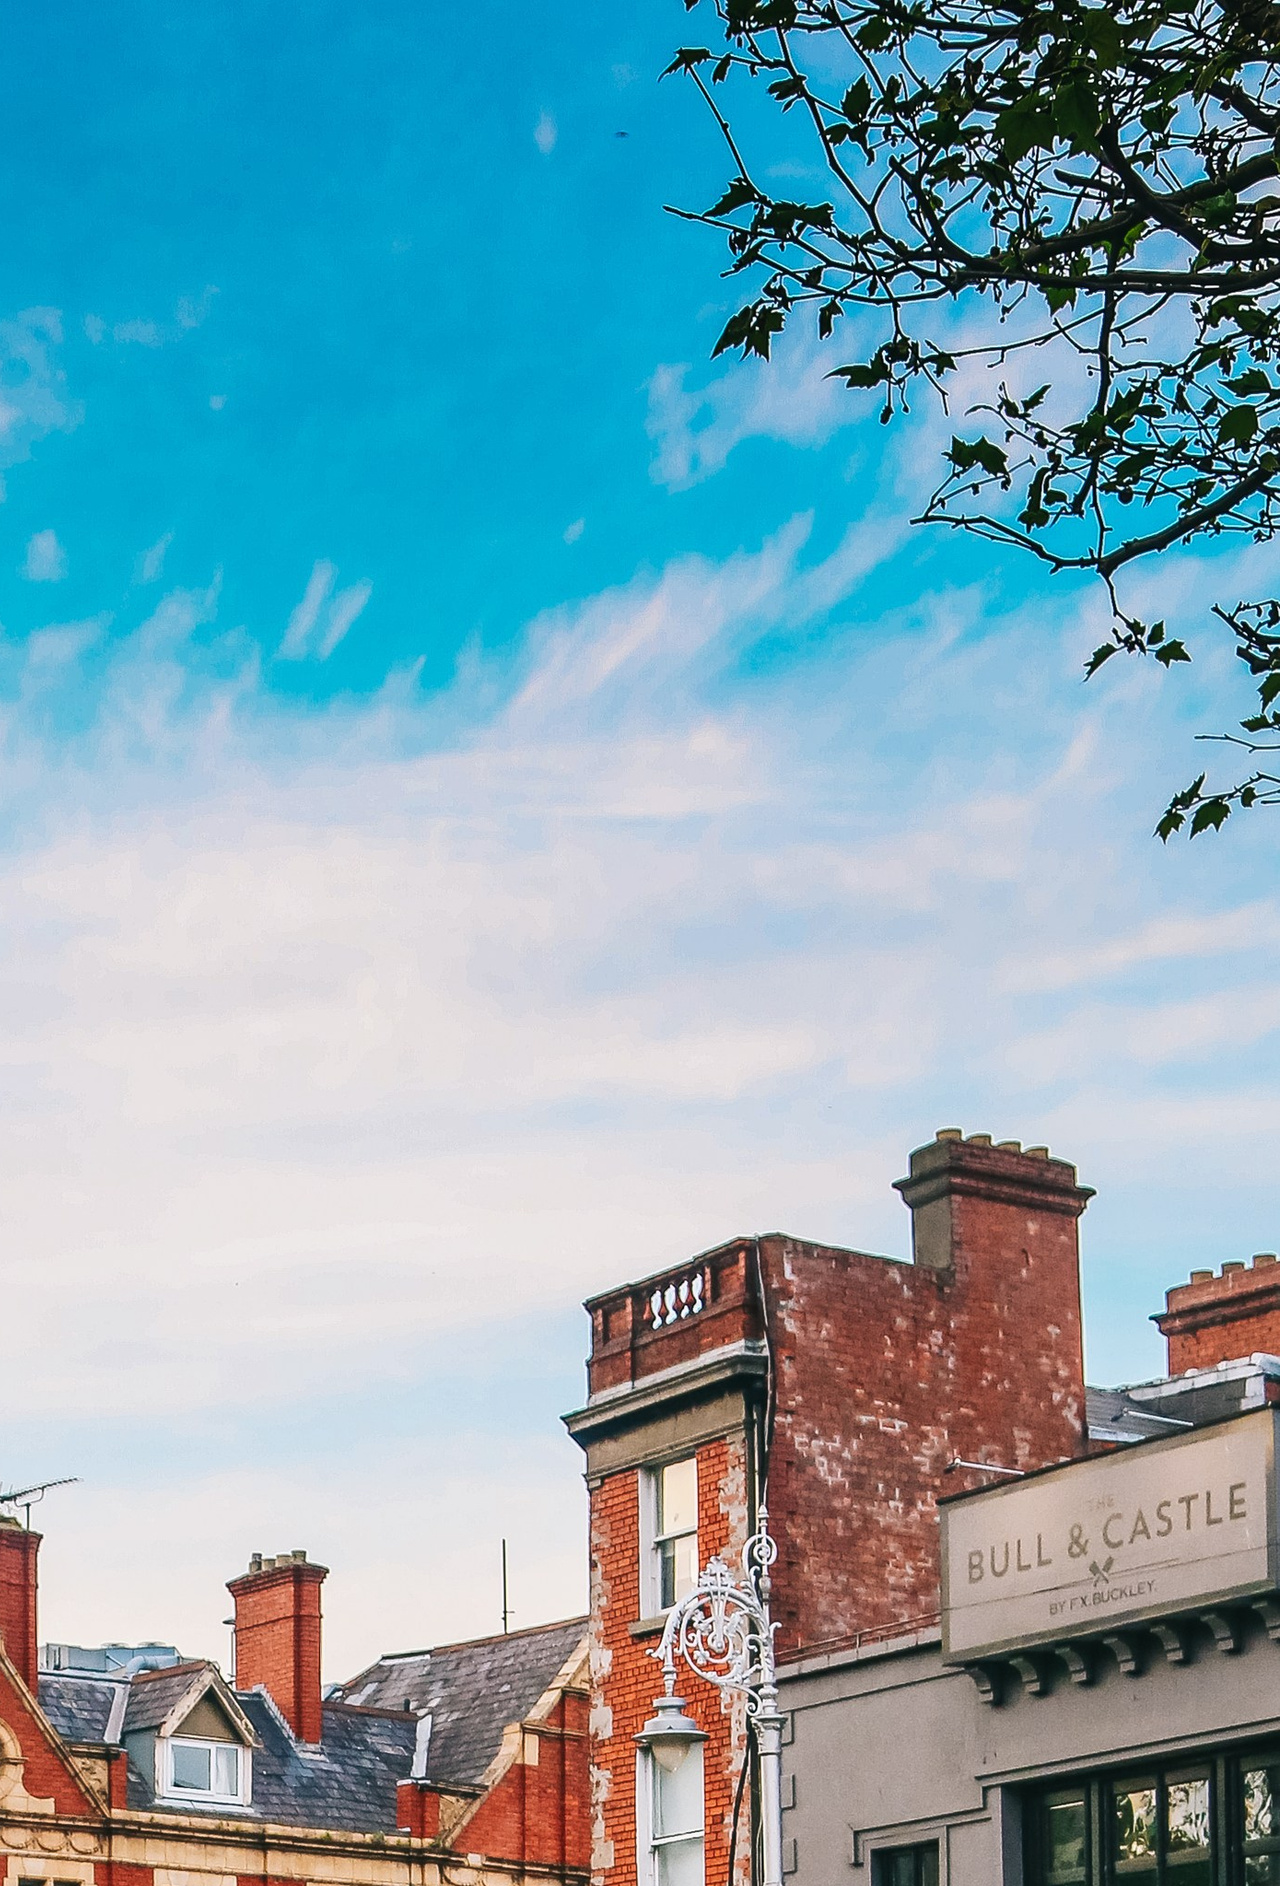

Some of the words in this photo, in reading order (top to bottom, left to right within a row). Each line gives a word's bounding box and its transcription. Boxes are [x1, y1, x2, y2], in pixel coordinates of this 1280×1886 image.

[968, 1533, 1053, 1584] BULL
[1067, 1522, 1091, 1559] &
[1102, 1482, 1248, 1550] CASTLE
[1049, 1601, 1066, 1615] BY
